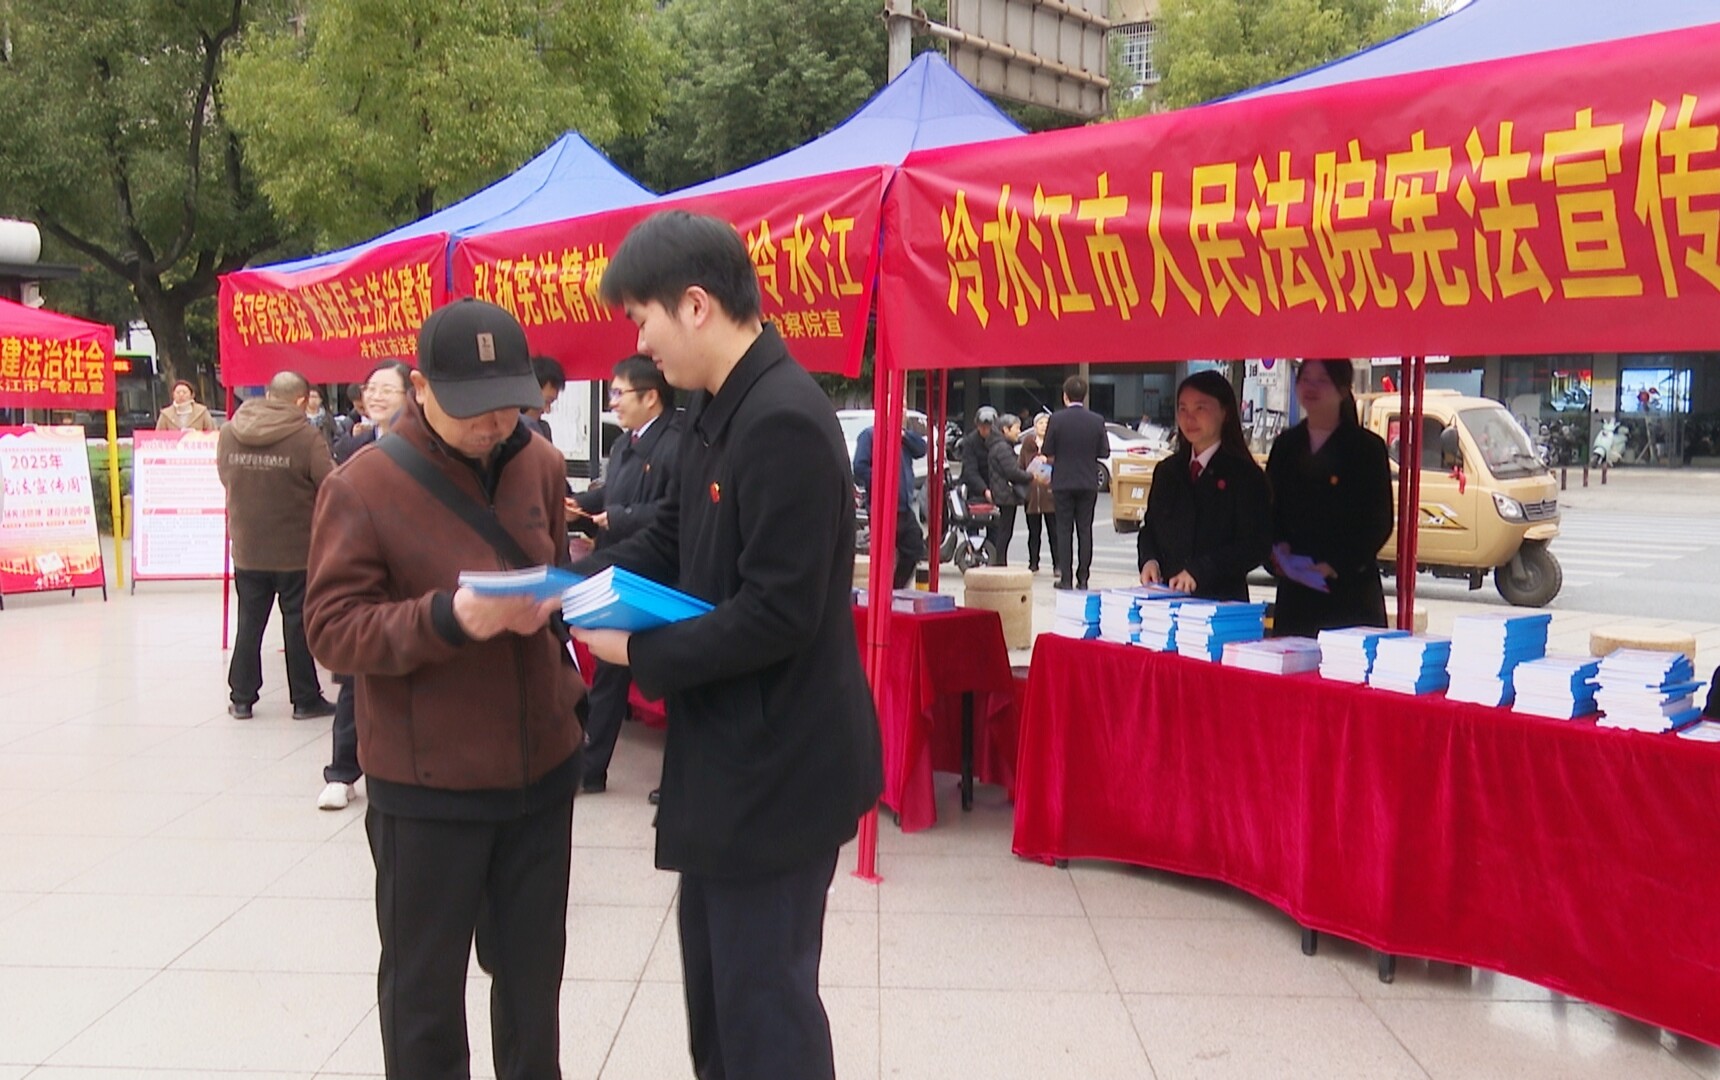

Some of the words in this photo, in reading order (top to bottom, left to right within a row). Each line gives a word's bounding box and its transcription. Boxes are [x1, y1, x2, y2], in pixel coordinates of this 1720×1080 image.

[940, 93, 1720, 330] 冷水江市人民法院宪法宣传
[233, 291, 314, 346] 学习宣传宪法
[299, 262, 433, 341] 推进民主法治建设
[10, 453, 63, 470] 2025年
